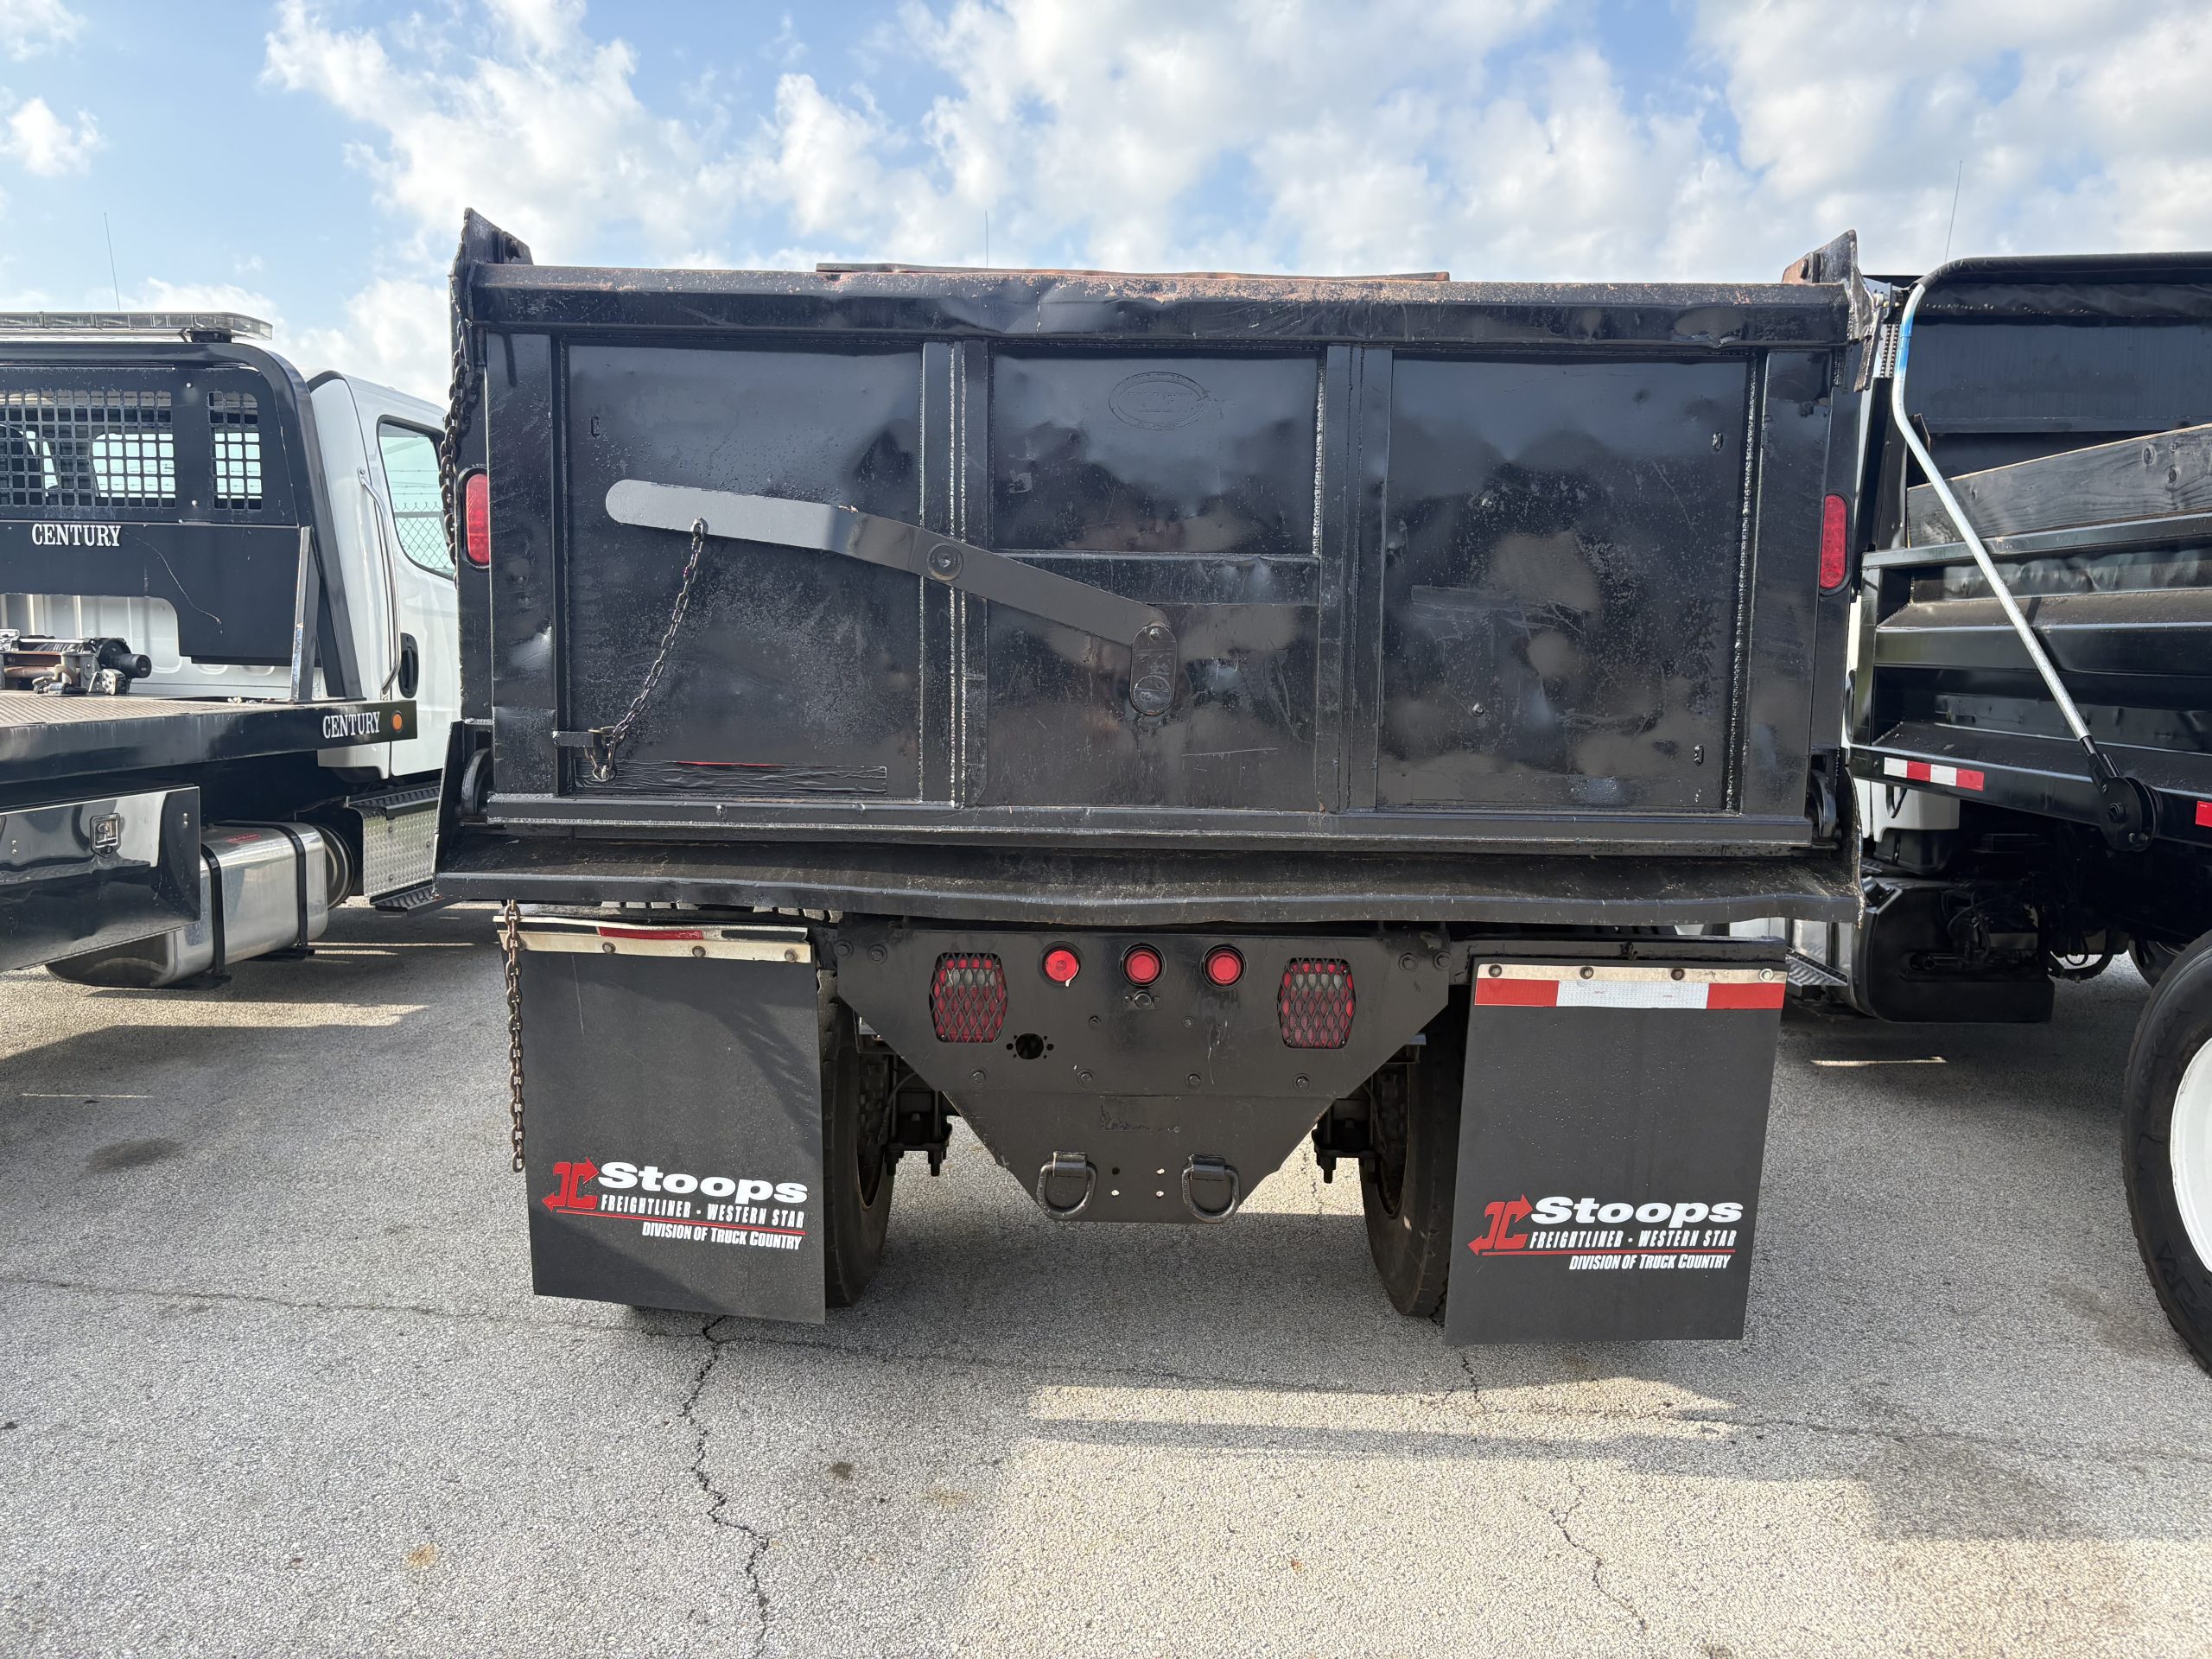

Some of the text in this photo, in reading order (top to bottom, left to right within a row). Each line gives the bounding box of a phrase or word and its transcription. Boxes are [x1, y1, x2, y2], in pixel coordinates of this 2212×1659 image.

[32, 523, 122, 547] CENTURY
[322, 711, 380, 739] CENTURY
[597, 1161, 809, 1205] Stoops
[601, 1193, 805, 1229] FREIGHTLINER WESTERN STAR
[1531, 1196, 1744, 1229] Stoops
[641, 1221, 804, 1250] DIVISION OF TRUCK COUNTRY
[1529, 1230, 1738, 1249] FREIGHTLINER WESTERN STAR
[1568, 1254, 1732, 1271] DIVISION OF TRUCK COUNTRY
